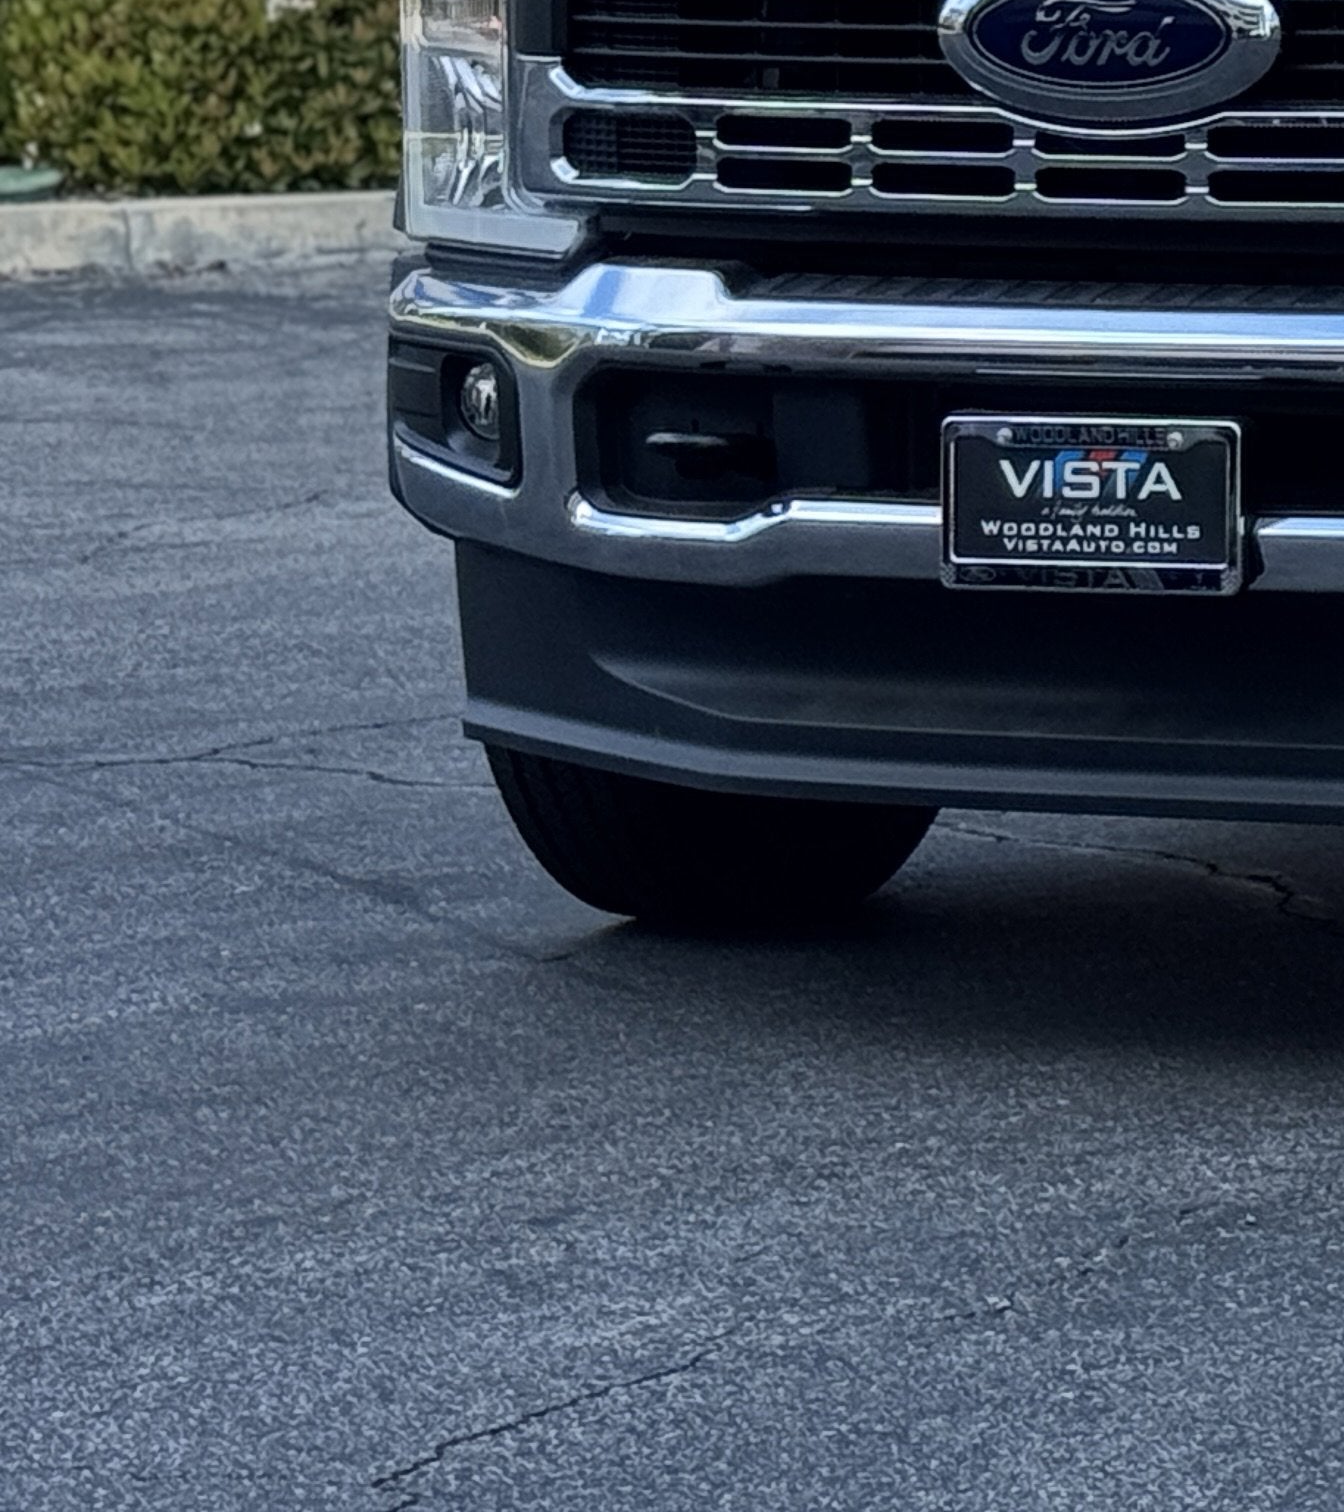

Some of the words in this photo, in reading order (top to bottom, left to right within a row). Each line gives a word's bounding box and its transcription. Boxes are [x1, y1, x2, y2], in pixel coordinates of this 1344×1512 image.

[999, 459, 1182, 501] VISTA
[981, 519, 1119, 538] WOODLAND
[1129, 519, 1201, 539] HILLS
